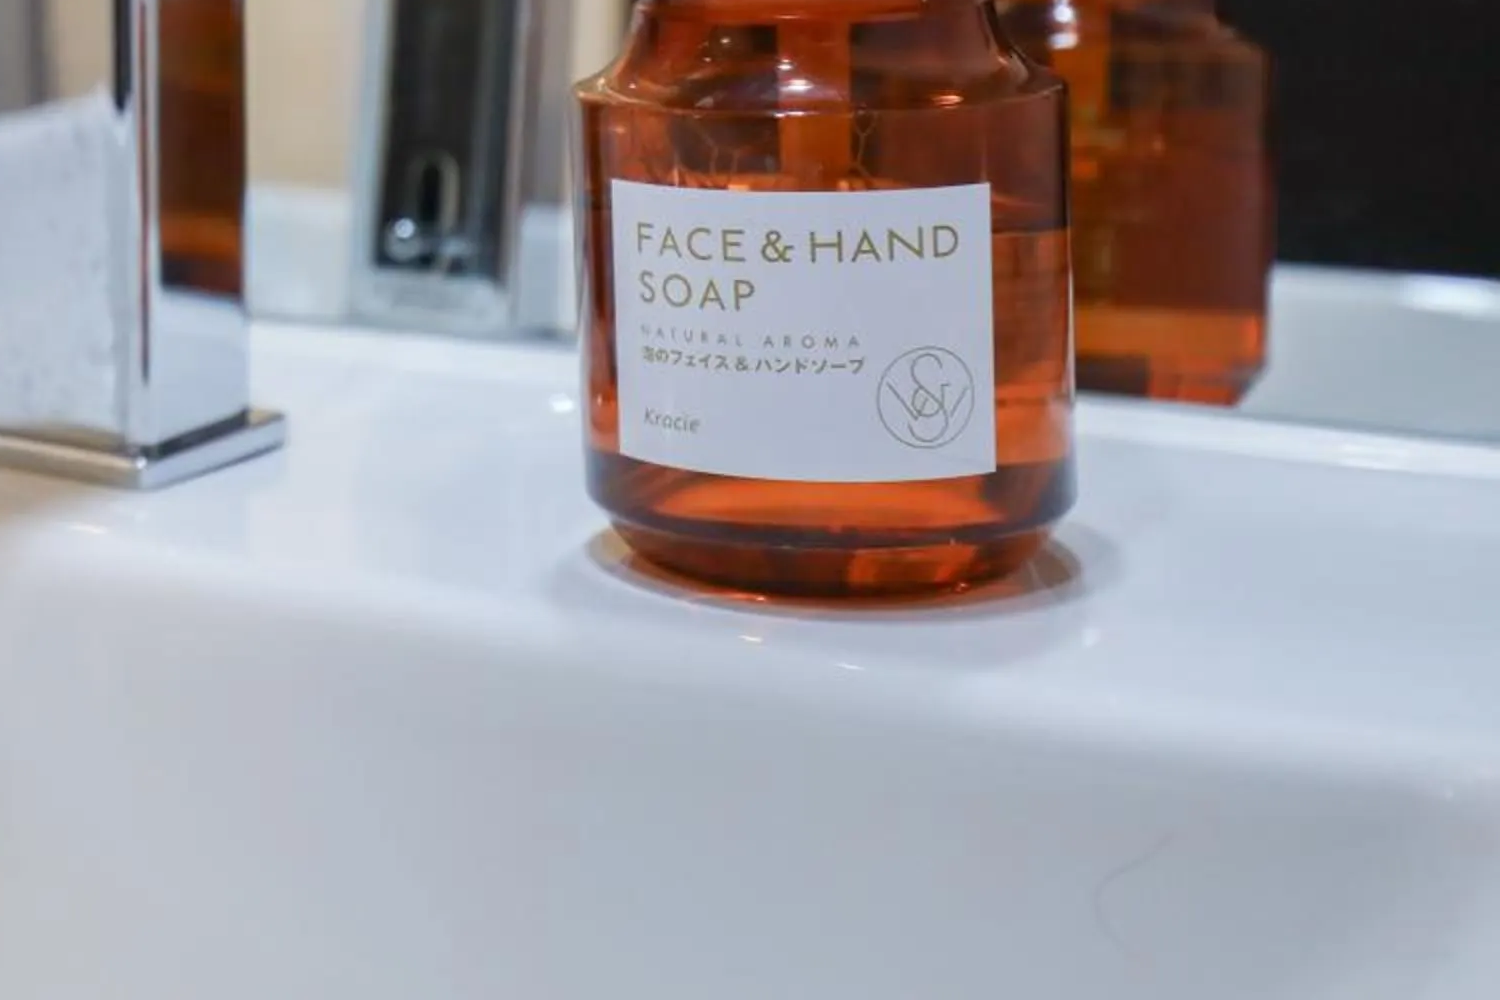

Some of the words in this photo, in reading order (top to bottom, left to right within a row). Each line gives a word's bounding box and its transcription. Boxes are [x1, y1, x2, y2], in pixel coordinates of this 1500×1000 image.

[636, 222, 747, 263] FACE
[760, 229, 795, 263] &
[809, 224, 960, 264] HAND
[638, 269, 756, 312] SOAP
[640, 323, 745, 348] NATURAL
[762, 333, 861, 350] AROMA
[643, 406, 701, 435] Kracie
